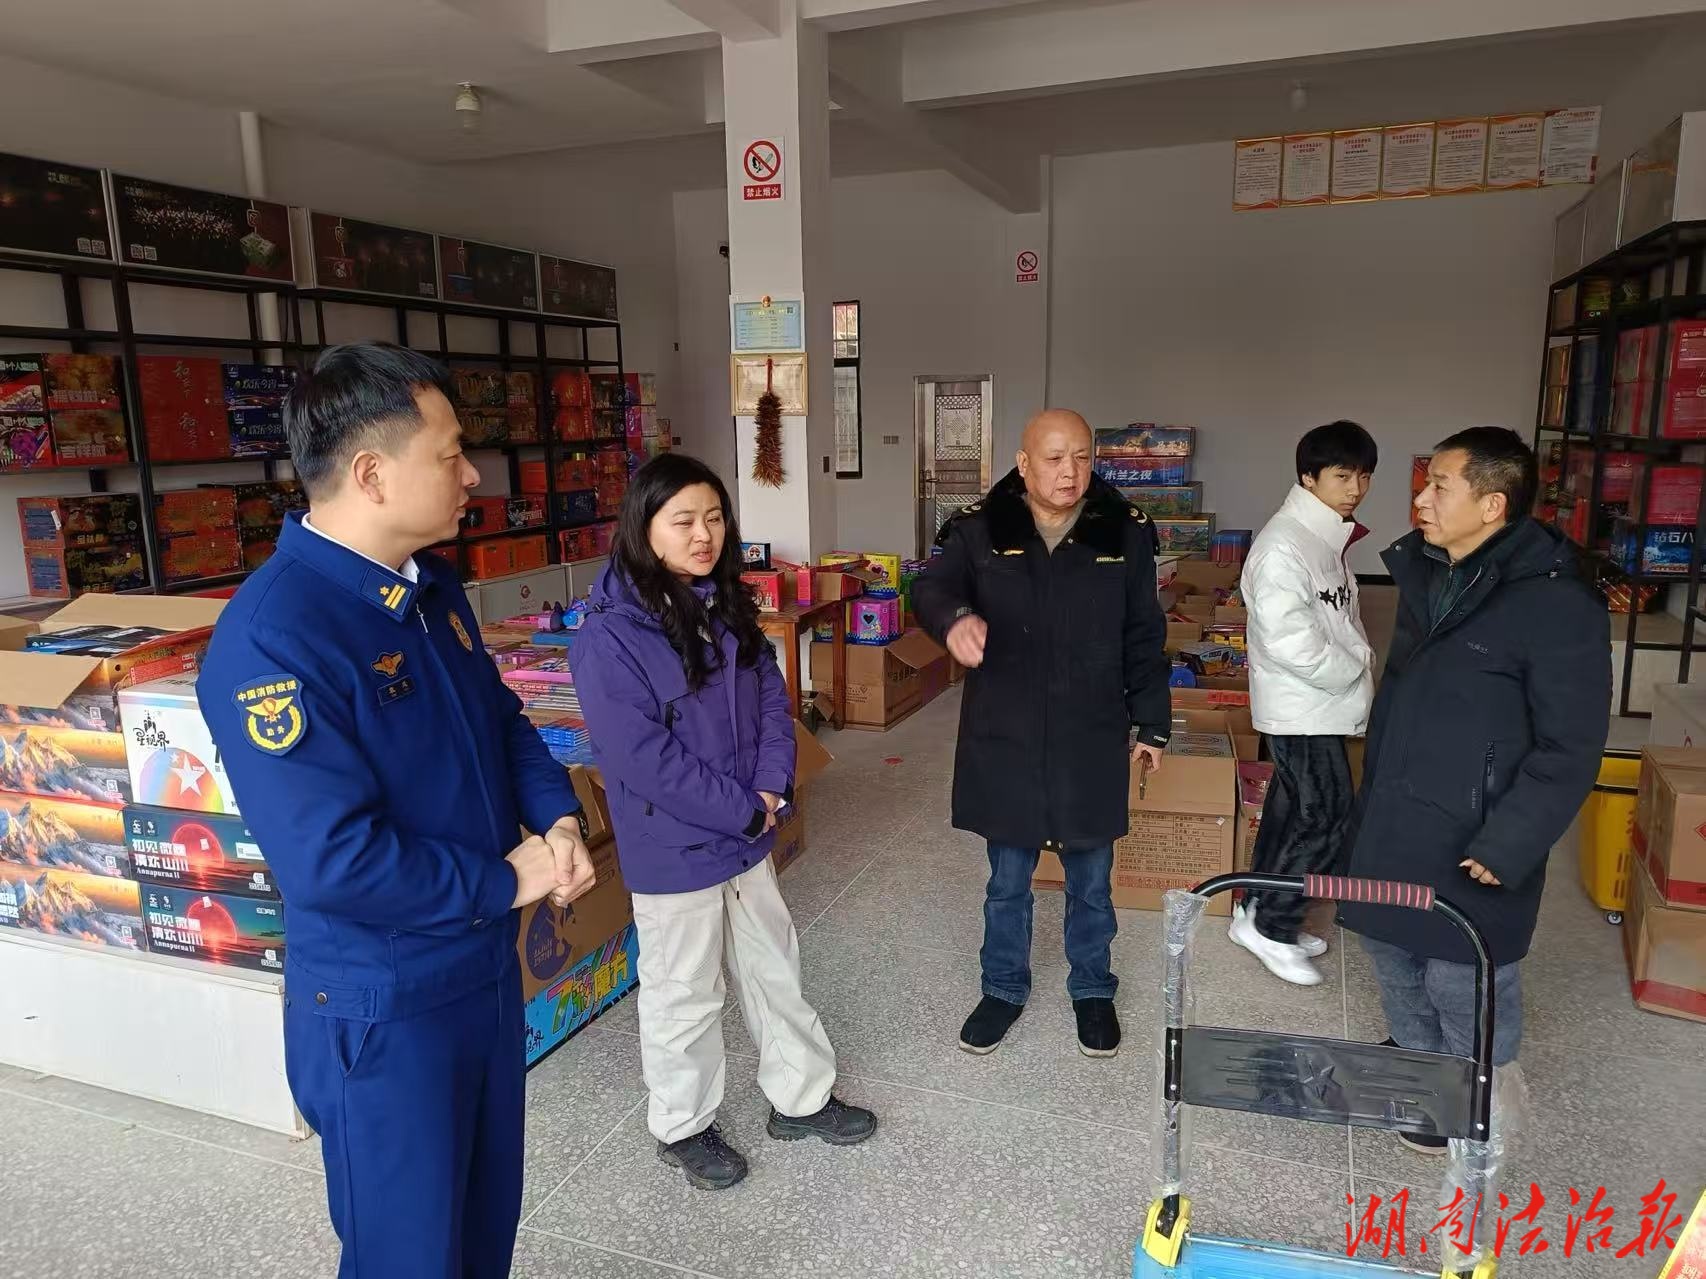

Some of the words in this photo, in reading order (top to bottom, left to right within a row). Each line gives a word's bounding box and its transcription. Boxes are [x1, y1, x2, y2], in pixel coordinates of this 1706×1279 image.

[746, 187, 779, 197] 禁止烟火
[237, 679, 298, 703] 中国消防救援
